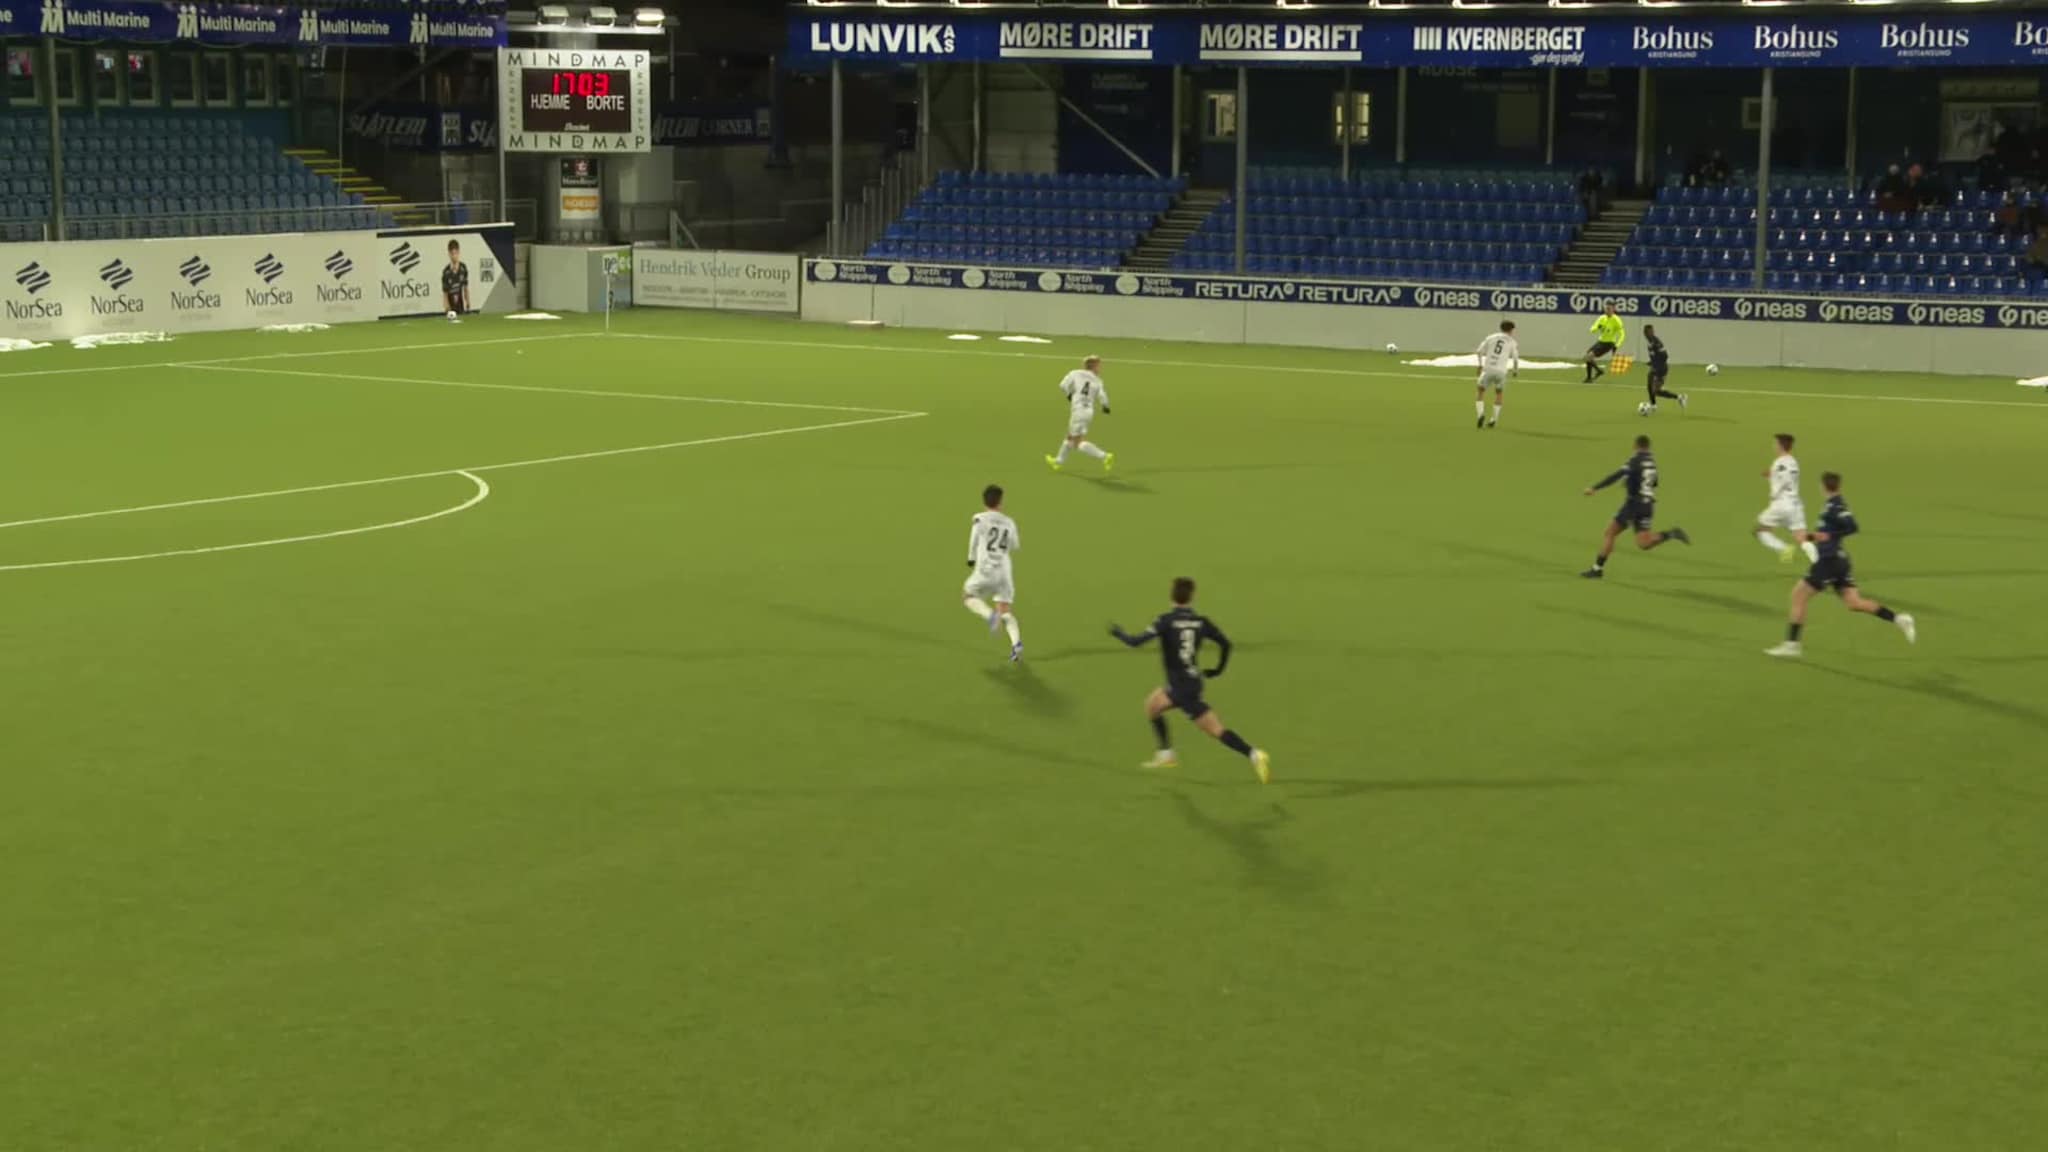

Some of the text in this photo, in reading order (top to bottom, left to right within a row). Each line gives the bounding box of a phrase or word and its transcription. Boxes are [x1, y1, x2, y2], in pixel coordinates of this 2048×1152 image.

[67, 10, 149, 28] Multi Marine
[201, 16, 276, 33] Multi Marine
[320, 18, 390, 35] Multi Marine
[430, 21, 494, 38] Multi Marine
[811, 22, 944, 53] LUNVIK
[1000, 22, 1153, 49] MØRE DRIFT
[1200, 24, 1363, 49] MØRE DRIFT
[1446, 26, 1586, 51] KVERNBERGET
[1632, 25, 1714, 50] Bohus
[1754, 24, 1839, 49] Bohus
[1880, 22, 1970, 48] Bohus
[507, 52, 644, 68] MINDMAP
[530, 94, 625, 110] HJEMME BORTE
[509, 134, 645, 150] MINDMAP
[639, 258, 698, 276] Hendrik
[745, 263, 791, 284] Group
[171, 289, 222, 311] NorSea
[246, 286, 293, 307] NorSea
[316, 282, 362, 303] NorSea
[381, 279, 431, 300] NorSea
[7, 297, 63, 320] NorSea
[91, 293, 144, 315] NorSea
[1080, 381, 1091, 396] 4
[986, 525, 1009, 553] 24
